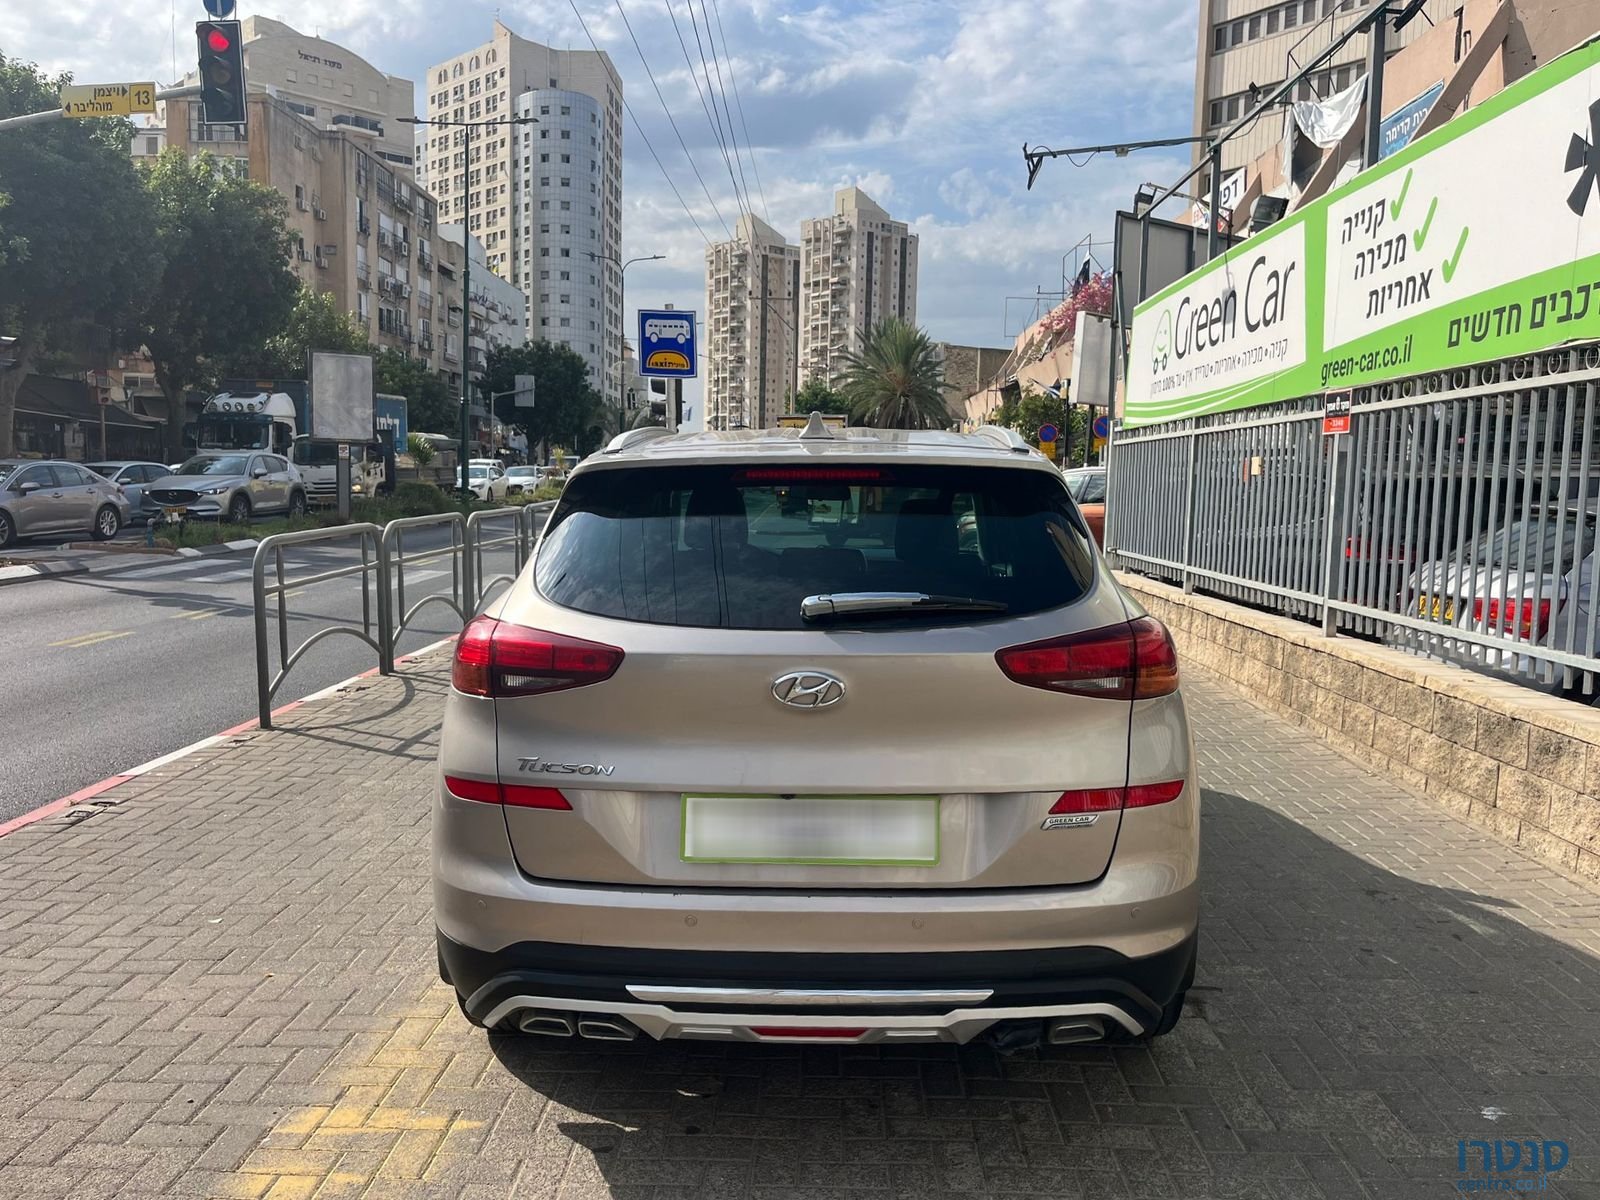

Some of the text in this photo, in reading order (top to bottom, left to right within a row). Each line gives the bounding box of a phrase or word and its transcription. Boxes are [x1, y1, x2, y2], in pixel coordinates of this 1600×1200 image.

[74, 99, 113, 112] מוהליבר
[93, 86, 120, 100] ויצמן
[134, 90, 150, 105] 13
[1385, 116, 1411, 144] קדימה
[1341, 198, 1386, 245] קנייה
[1354, 233, 1407, 280] מכירה
[1366, 268, 1433, 319] אחריות
[1174, 255, 1296, 360] Green Car
[1447, 303, 1523, 348] חדשים
[1241, 346, 1263, 368] מכירה
[1269, 338, 1288, 362] קניה
[1321, 334, 1413, 386] green-car.co.il
[1213, 354, 1237, 376] אחריות
[517, 756, 616, 777] TUCSON
